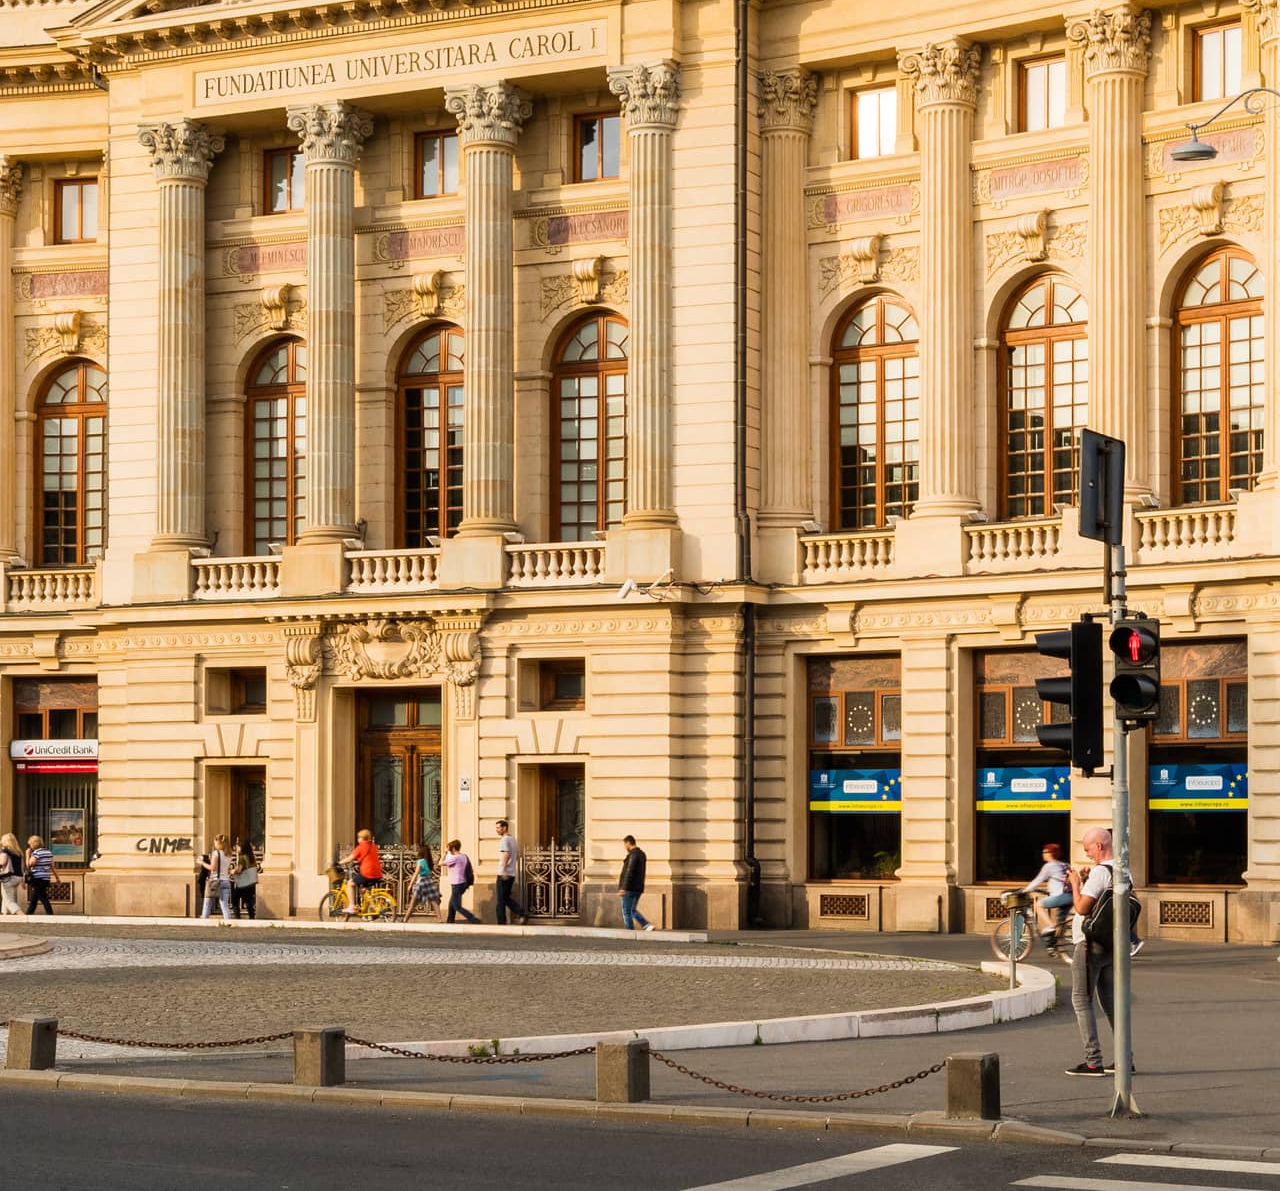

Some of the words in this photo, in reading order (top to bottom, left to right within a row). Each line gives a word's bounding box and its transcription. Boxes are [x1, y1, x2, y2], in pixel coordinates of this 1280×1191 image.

[204, 62, 337, 99] FUNDATIUNEA
[346, 41, 499, 81] UNIVERSITARA
[509, 30, 582, 60] CAROL
[591, 27, 598, 49] I
[35, 745, 71, 755] UniCredit
[73, 745, 94, 755] Bank
